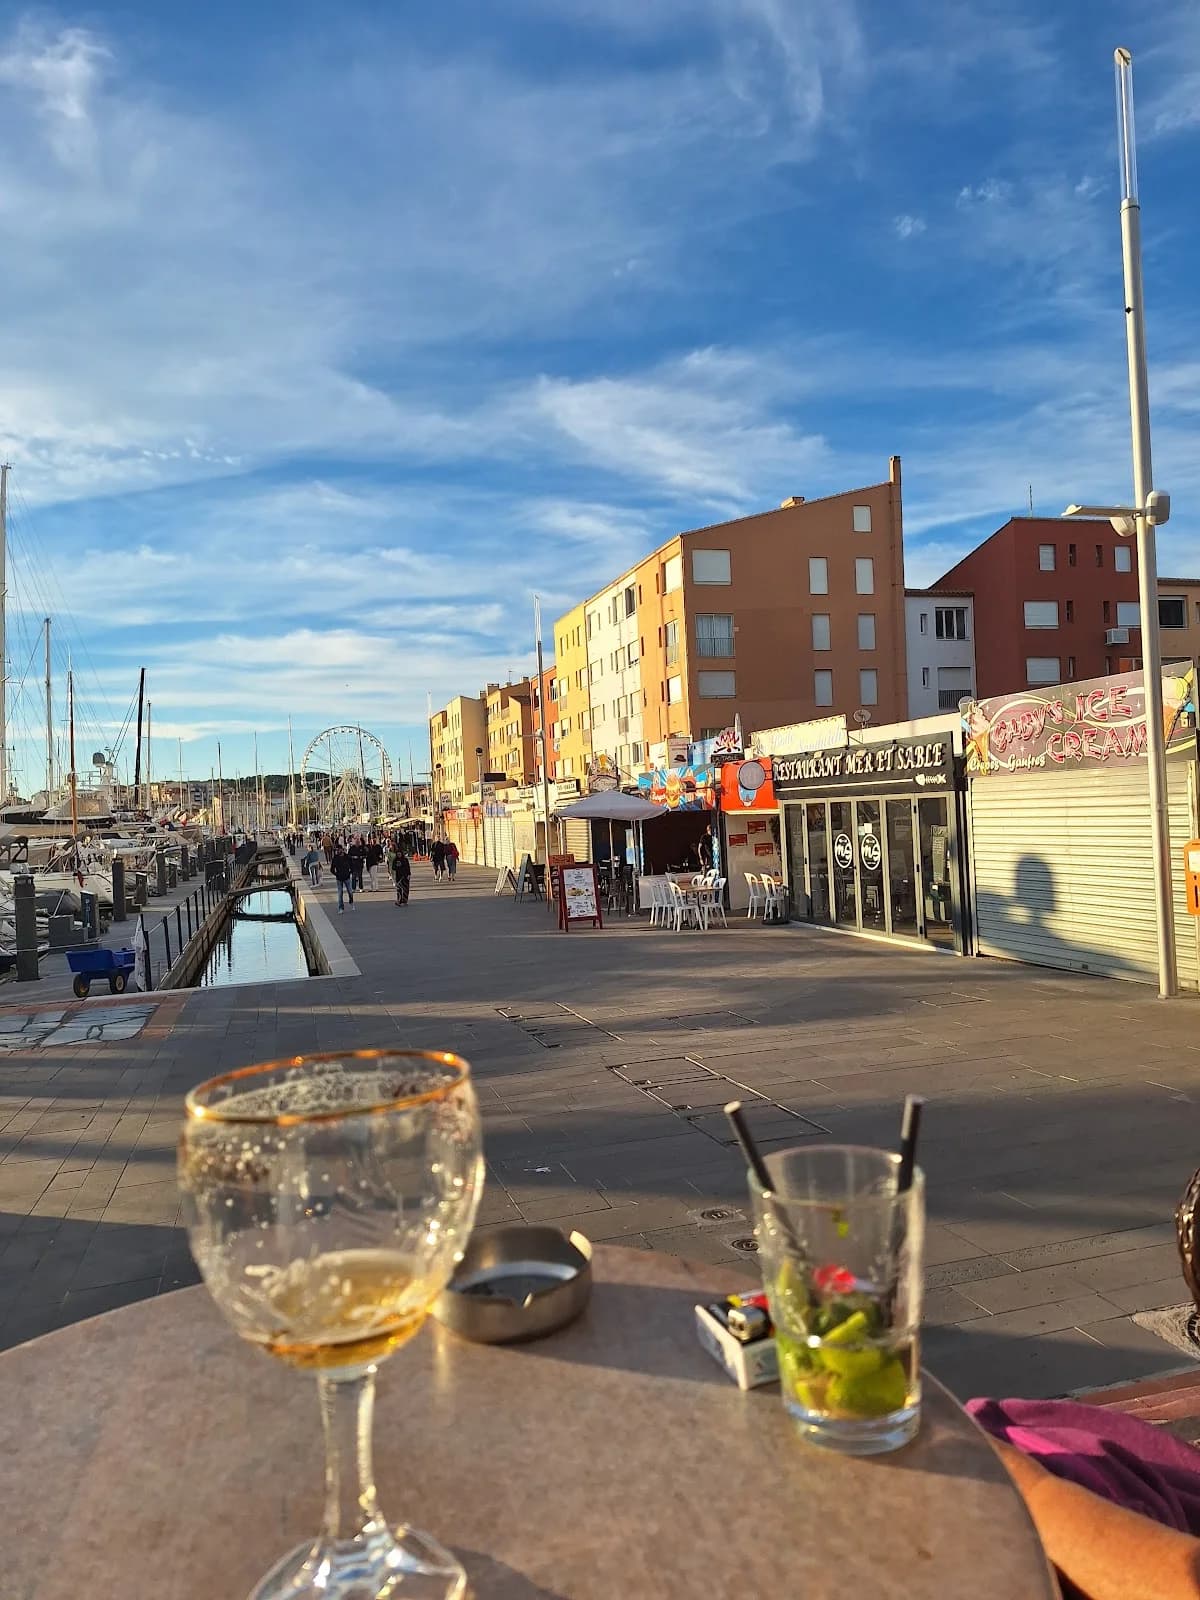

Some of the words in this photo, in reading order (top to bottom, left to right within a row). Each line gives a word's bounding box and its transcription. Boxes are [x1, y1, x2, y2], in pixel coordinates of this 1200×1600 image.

[991, 700, 1064, 753] GABY'S
[1074, 684, 1133, 723] ICE
[773, 755, 843, 780] RESTAURANT
[845, 751, 874, 774] MER
[877, 746, 896, 771] ET
[897, 742, 944, 770] SABLE
[1007, 753, 1045, 771] Gaufres
[1046, 722, 1148, 764] CREAM
